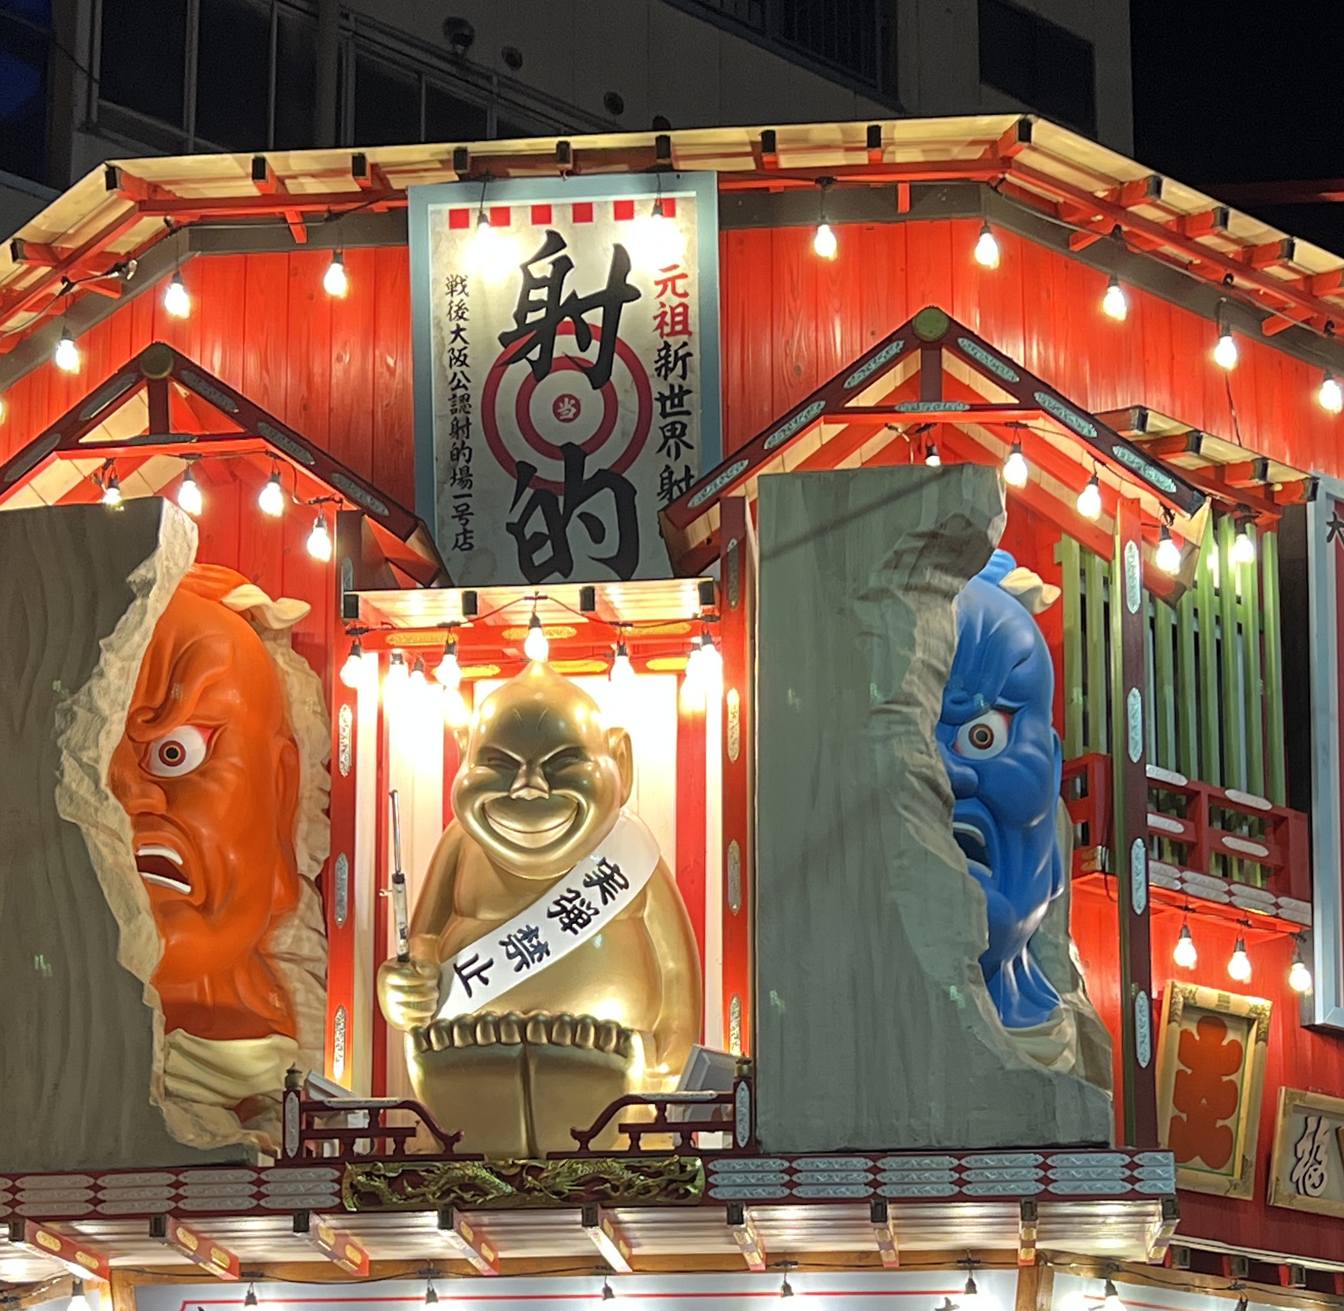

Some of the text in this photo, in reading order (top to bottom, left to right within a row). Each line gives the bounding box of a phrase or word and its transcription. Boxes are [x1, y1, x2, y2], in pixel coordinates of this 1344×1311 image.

[445, 274, 475, 552] 戦後大阪公認射的場一号店
[499, 229, 641, 583] 射的
[653, 263, 696, 505] 元祖新世界射
[453, 856, 631, 999] 実弾禁止
